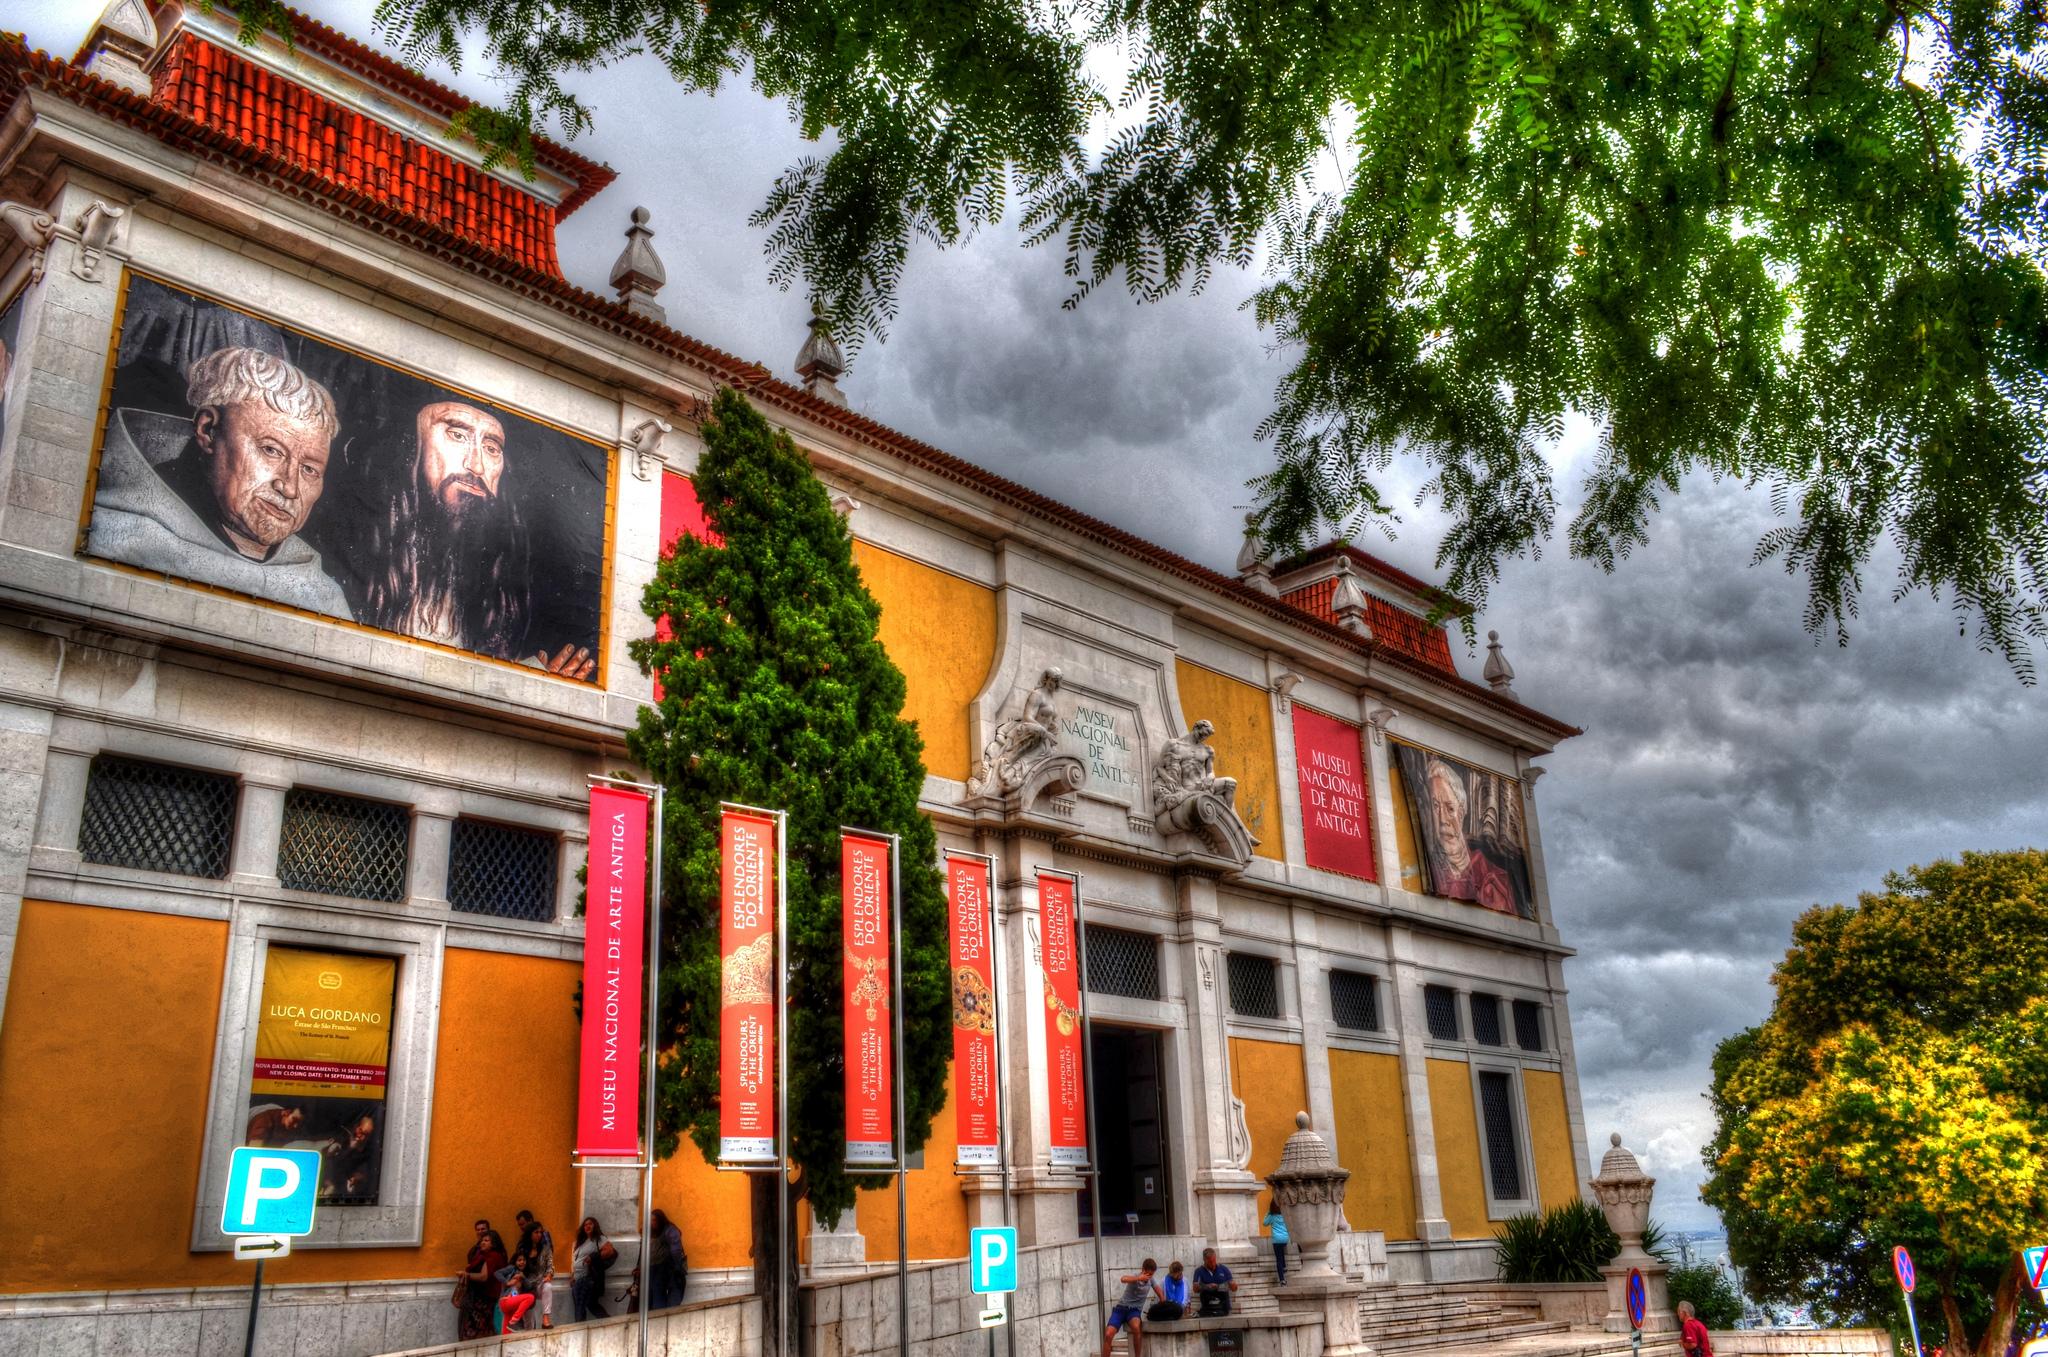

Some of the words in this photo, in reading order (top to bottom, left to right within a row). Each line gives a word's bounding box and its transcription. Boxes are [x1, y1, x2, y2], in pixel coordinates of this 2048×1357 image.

[1061, 718, 1131, 752] NACIONAL
[1076, 705, 1115, 730] MVSEV
[1089, 743, 1105, 761] DE
[1311, 749, 1351, 776] MUSEU
[1301, 765, 1365, 800] NACIONAL
[1311, 788, 1328, 808] DE
[1331, 795, 1361, 818] ARTE
[1315, 810, 1362, 838] ANTIGA
[611, 813, 625, 879] ANTIGA
[745, 831, 757, 897] ORIENTE
[733, 826, 745, 929] ESPLENDORES
[863, 855, 874, 916] ORIENTE
[609, 886, 623, 930] ARTE
[745, 902, 757, 927] DO
[852, 849, 864, 946] ESPLENDORES
[956, 869, 969, 960] ESPLENDORES
[966, 875, 977, 932] ORIENTE
[864, 921, 875, 944] DO
[1046, 886, 1059, 973] ESPLENDORES
[1054, 891, 1065, 946] ORIENTE
[608, 937, 621, 959] DE
[969, 936, 979, 958] DO
[1057, 950, 1067, 971] DO
[270, 1004, 306, 1018] LUCA
[309, 1008, 381, 1024] GIORDANO
[605, 967, 620, 1062] NACIONAL
[740, 1019, 748, 1087] SPLENDOURS
[748, 1015, 757, 1053] ORIENT
[748, 1056, 757, 1075] THE
[861, 1031, 869, 1094] SPLENDOURS
[969, 1041, 977, 1101] SPLENDOURS
[602, 1070, 616, 1131] MUSEU
[748, 1080, 757, 1094] OF
[869, 1088, 876, 1100] OF
[977, 1094, 984, 1107] OF
[241, 1157, 300, 1225] P
[980, 1234, 1008, 1286] P
